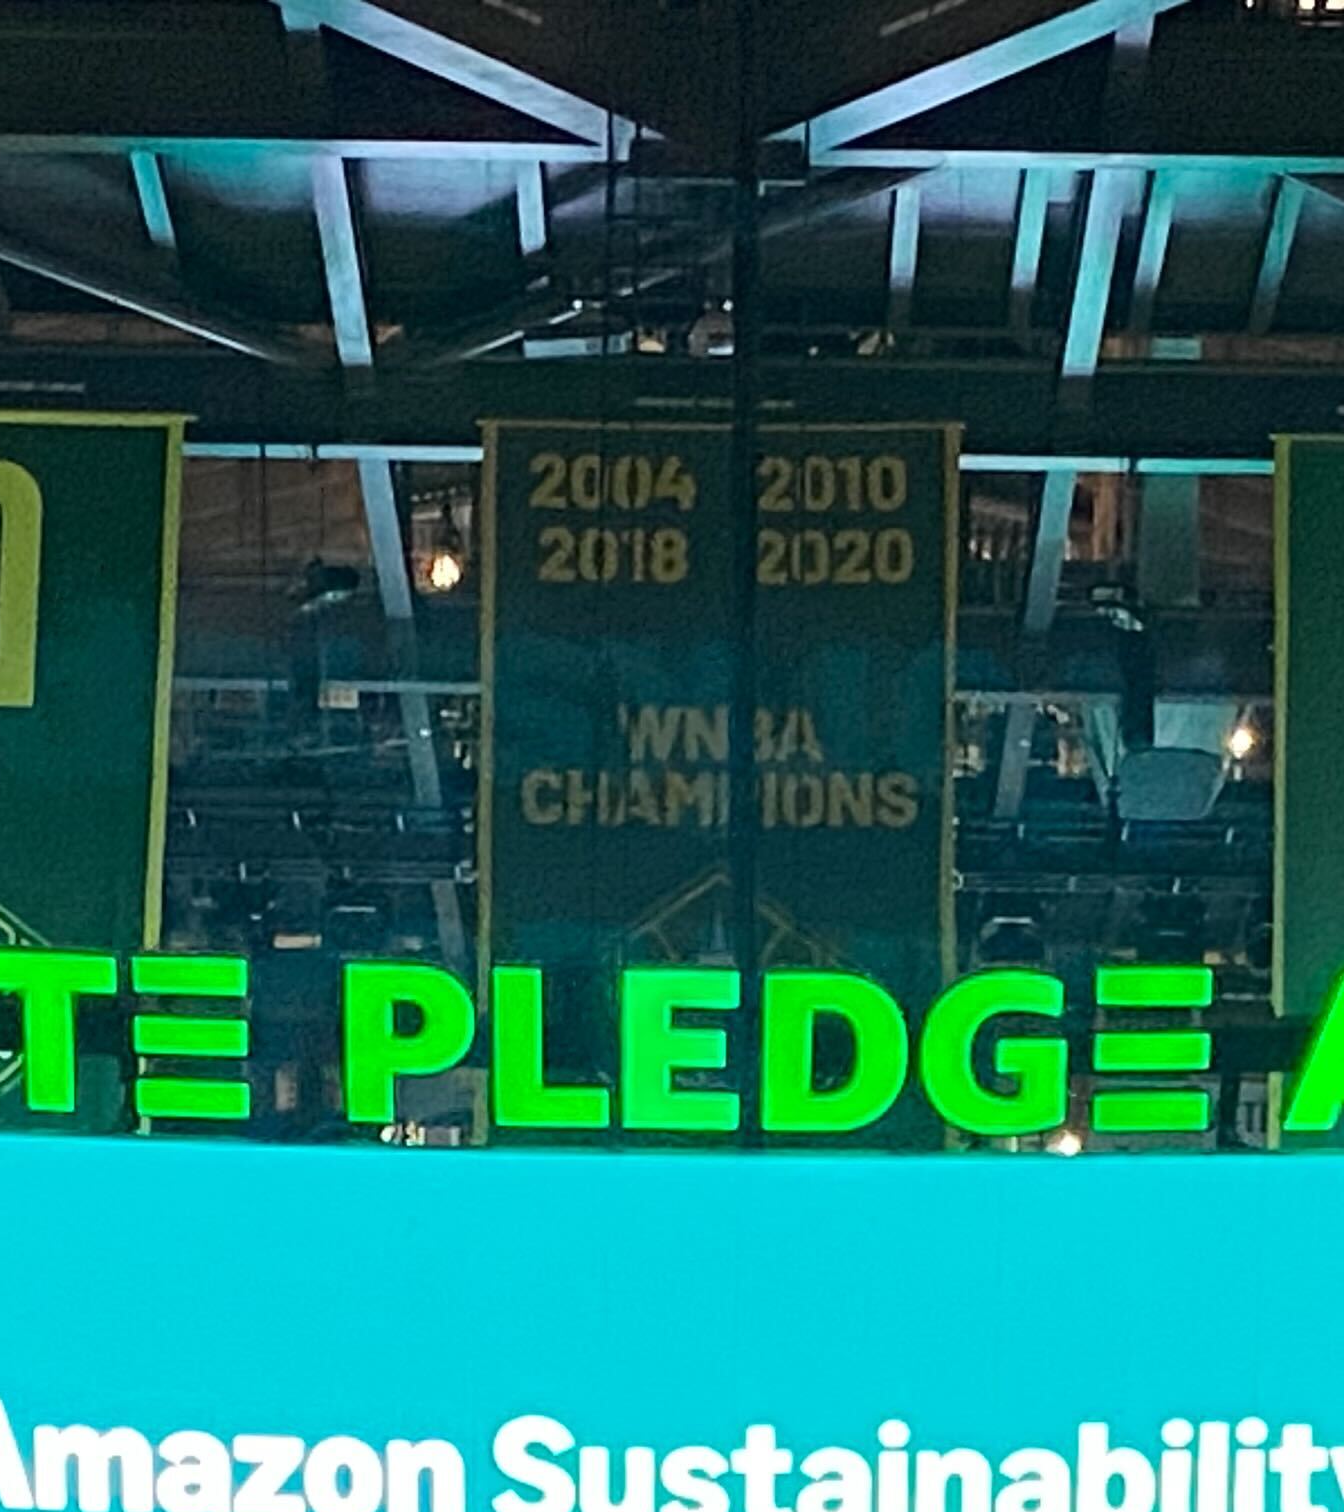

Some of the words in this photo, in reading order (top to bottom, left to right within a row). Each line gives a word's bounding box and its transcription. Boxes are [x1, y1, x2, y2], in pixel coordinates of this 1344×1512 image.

[528, 451, 699, 513] 2004
[754, 454, 909, 513] 2010
[536, 525, 690, 584] 2018
[754, 527, 916, 585] 2020
[342, 962, 1215, 1140] PLEDGE
